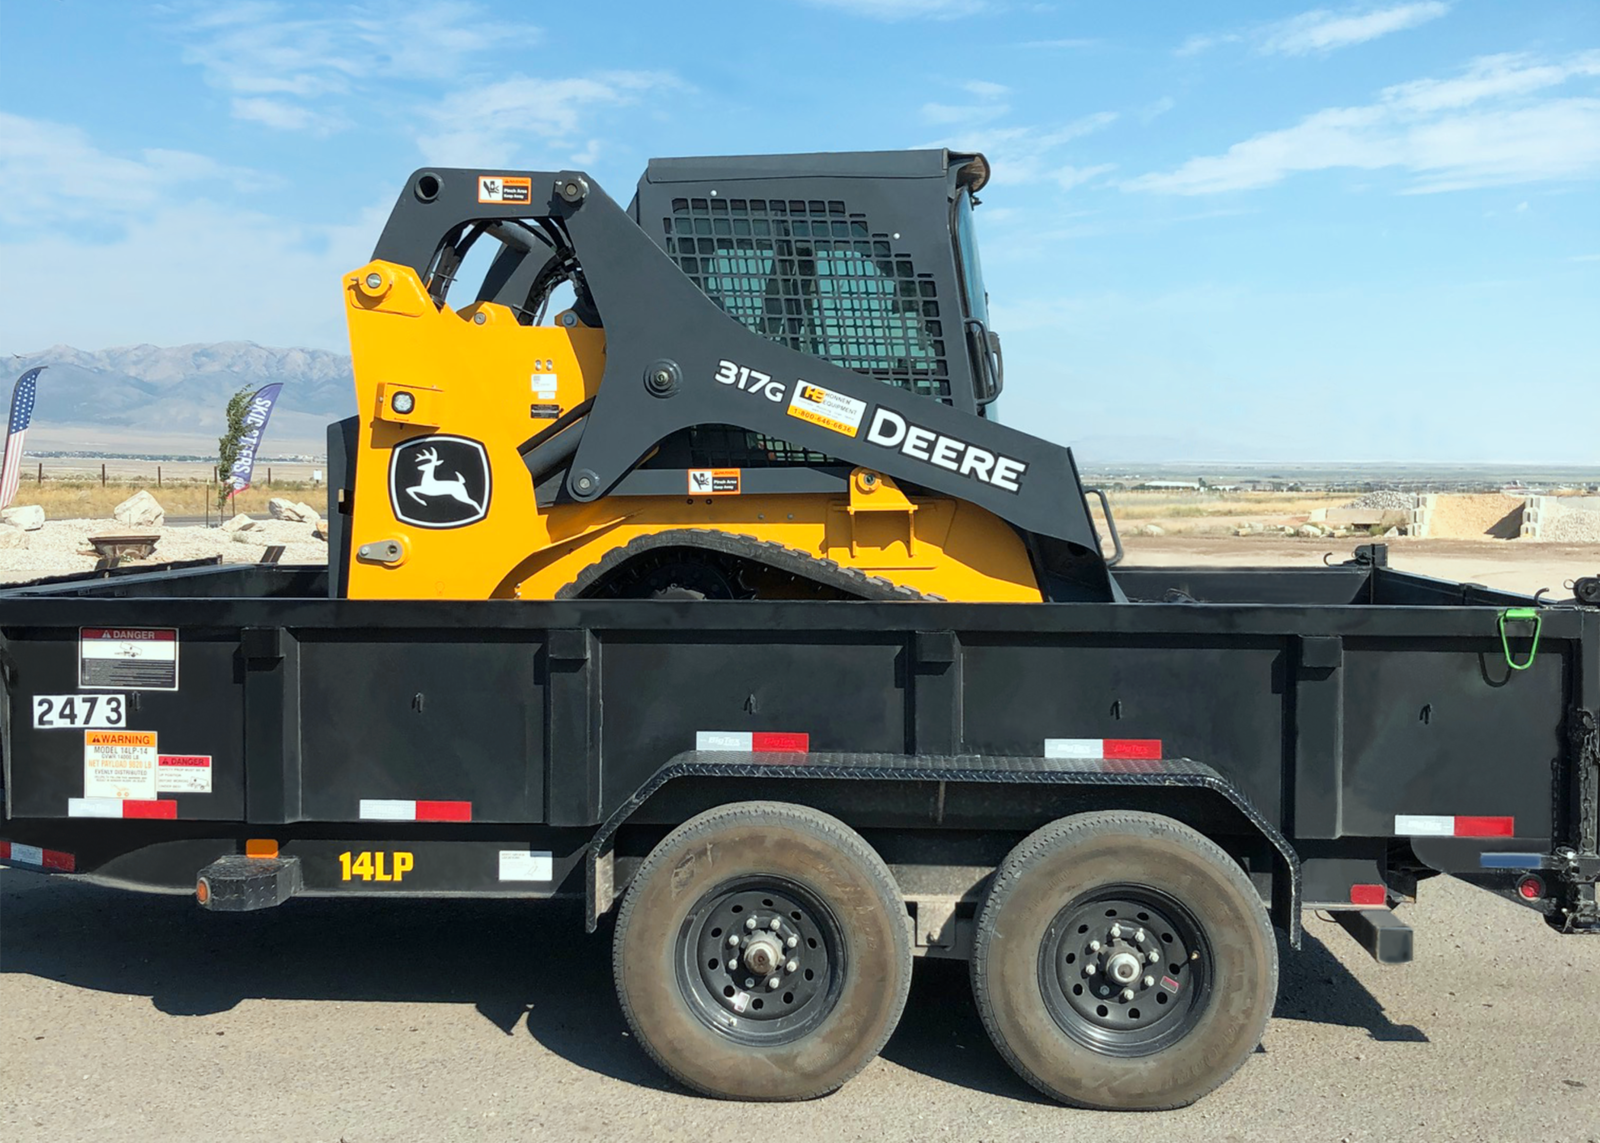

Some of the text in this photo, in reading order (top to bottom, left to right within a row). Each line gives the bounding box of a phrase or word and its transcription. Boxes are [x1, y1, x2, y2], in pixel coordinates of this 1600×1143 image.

[714, 360, 786, 402] 317G
[826, 392, 852, 405] HONNEN
[822, 400, 858, 416] EQUIPMENT
[867, 408, 1026, 492] DEERE
[113, 630, 155, 639] DANGER
[37, 696, 122, 726] 2473
[101, 734, 150, 744] WARNING
[94, 746, 118, 754] MODEL
[88, 760, 100, 768] NET
[102, 760, 128, 768] PAYLOAD
[144, 761, 152, 769] LB
[338, 851, 414, 882] 14LP
